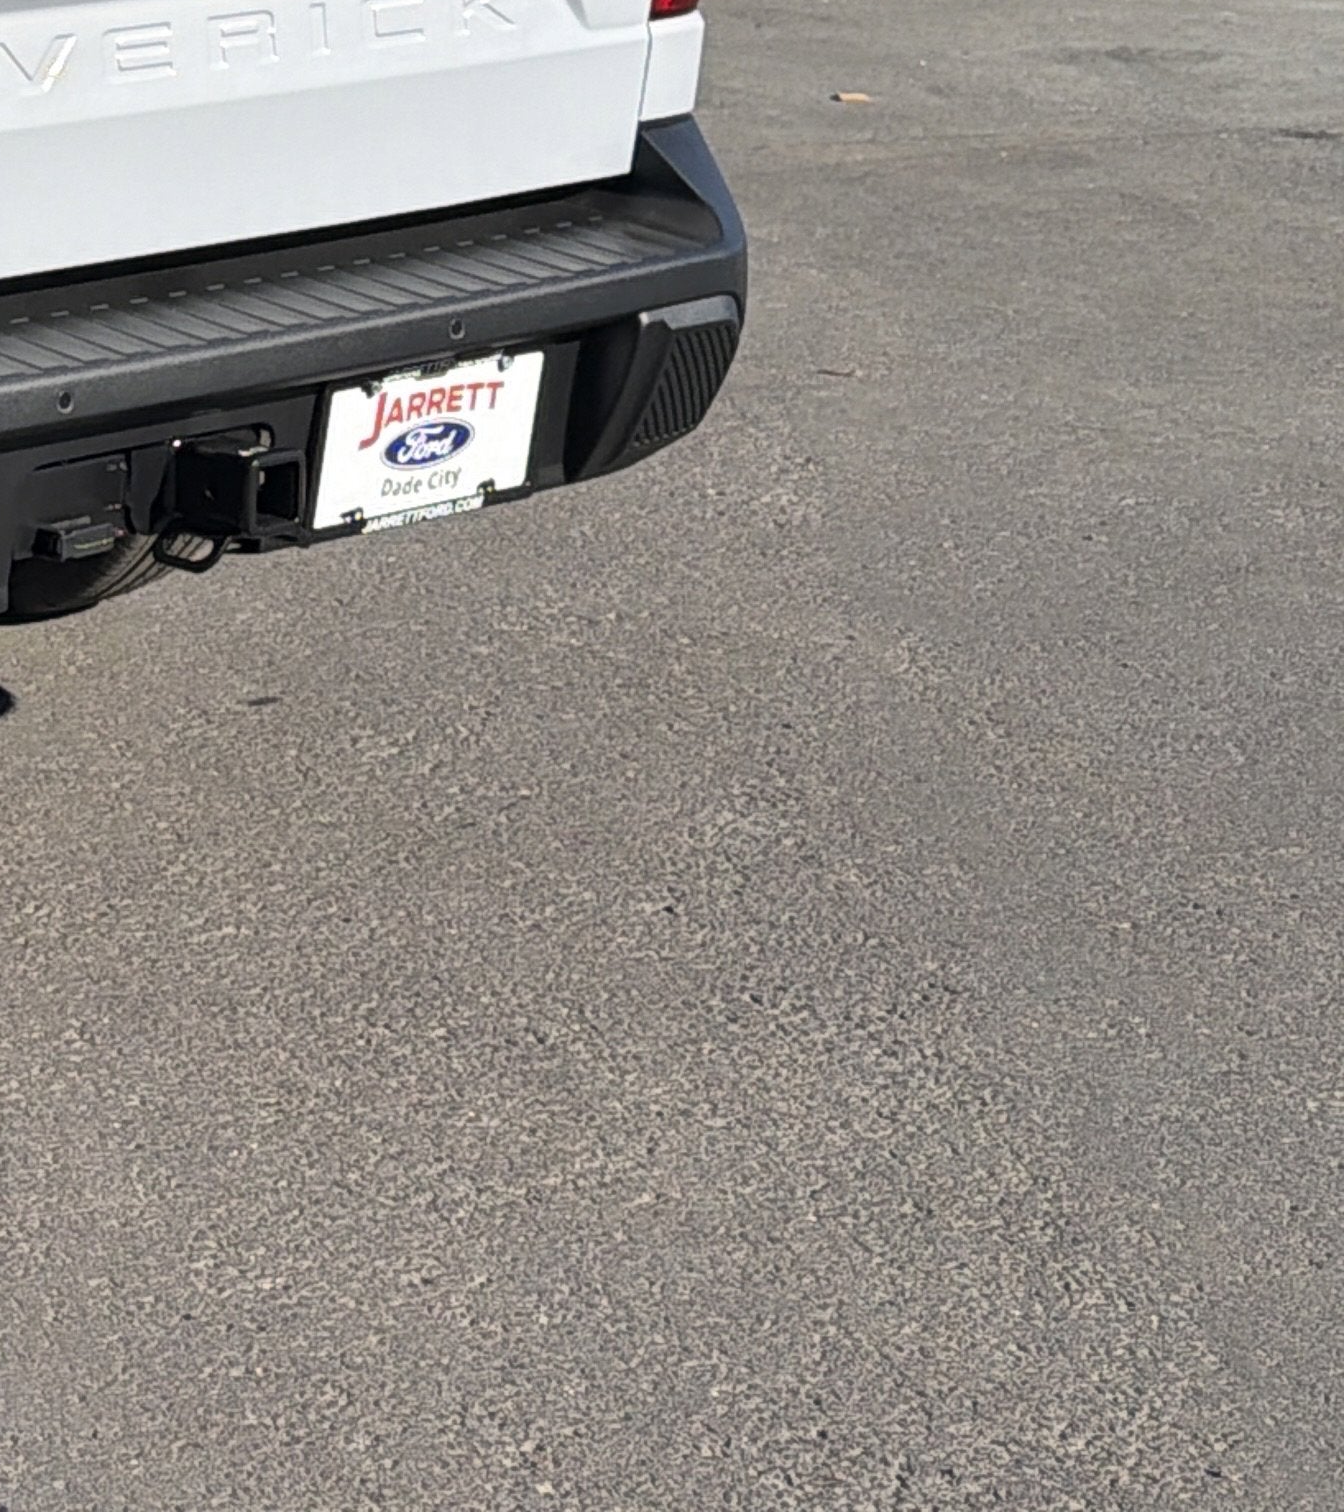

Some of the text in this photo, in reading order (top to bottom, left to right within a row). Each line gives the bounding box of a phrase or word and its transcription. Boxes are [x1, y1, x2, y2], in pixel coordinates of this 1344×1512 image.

[358, 381, 505, 450] JARRETT
[397, 424, 457, 464] Ford
[381, 467, 461, 497] Dade City
[362, 495, 485, 535] JARRETTFORD.COM
